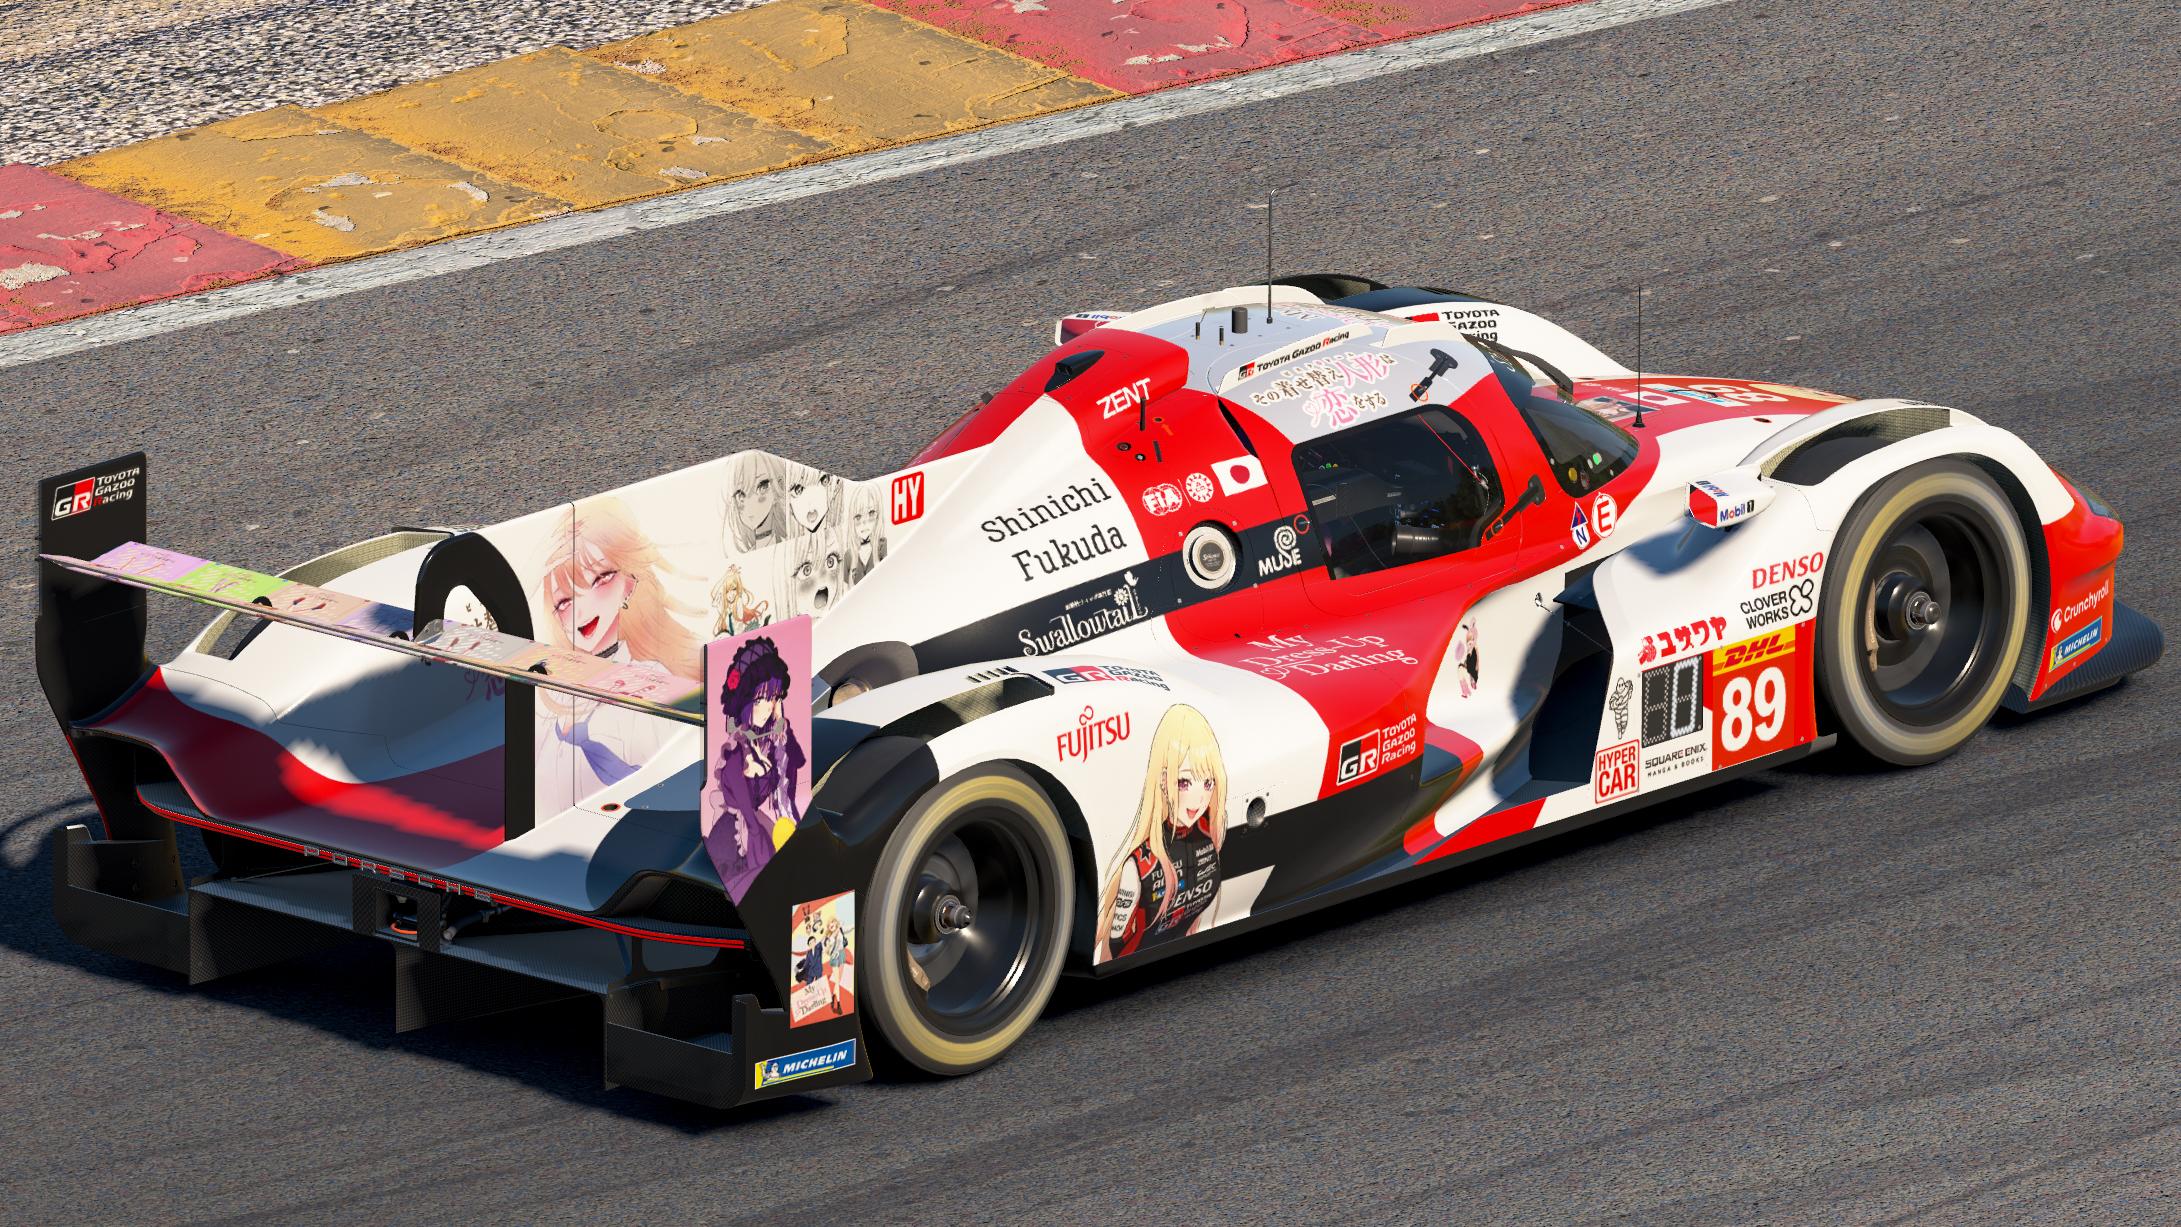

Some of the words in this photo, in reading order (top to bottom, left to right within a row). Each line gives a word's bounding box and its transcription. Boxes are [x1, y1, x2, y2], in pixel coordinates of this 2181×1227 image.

[1441, 309, 1500, 320] TOYOTA
[1257, 354, 1291, 372] TOYOTA
[1291, 343, 1322, 359] GAZOO
[1322, 330, 1350, 347] Racing
[1096, 377, 1151, 420] ZENT
[94, 478, 136, 497] GAZOO
[96, 467, 140, 486] TOYOTA
[54, 491, 91, 517] GR
[93, 489, 134, 507] Racing
[893, 474, 922, 522] HY
[980, 477, 1112, 543] Shinichi
[1143, 486, 1182, 514] FIA
[1597, 499, 1612, 533] E
[1719, 503, 1746, 522] Mobil
[1575, 528, 1588, 545] N
[1011, 523, 1128, 582] Fukuda
[1258, 526, 1302, 577] MUSE
[1752, 551, 1824, 590] DENSO
[1740, 591, 1788, 615] CLOVER
[2063, 578, 2110, 623] Crunchyroll
[1746, 606, 1789, 630] WORKS
[1238, 635, 1390, 668] Dress-Up
[1247, 634, 1314, 652] My
[1723, 633, 1785, 669] DHL
[2063, 626, 2100, 656] MICHELIN
[1055, 671, 1112, 683] GR
[1262, 650, 1419, 679] Darling
[1720, 666, 1787, 752] 89
[1056, 711, 1131, 763] FUJITSU
[1382, 712, 1417, 739] TOYOTA
[1381, 740, 1416, 765] Racing
[1382, 727, 1416, 753] GAZOO
[1340, 747, 1378, 780] GR
[1598, 745, 1636, 772] HYPER
[1644, 749, 1684, 770] SQUARE
[1684, 742, 1707, 757] ENIX
[1647, 765, 1671, 778] MANGA
[1681, 756, 1705, 768] BOOKS
[1598, 763, 1636, 798] CAR
[1172, 879, 1213, 909] ENSO
[782, 1049, 849, 1075] MICHELIN
